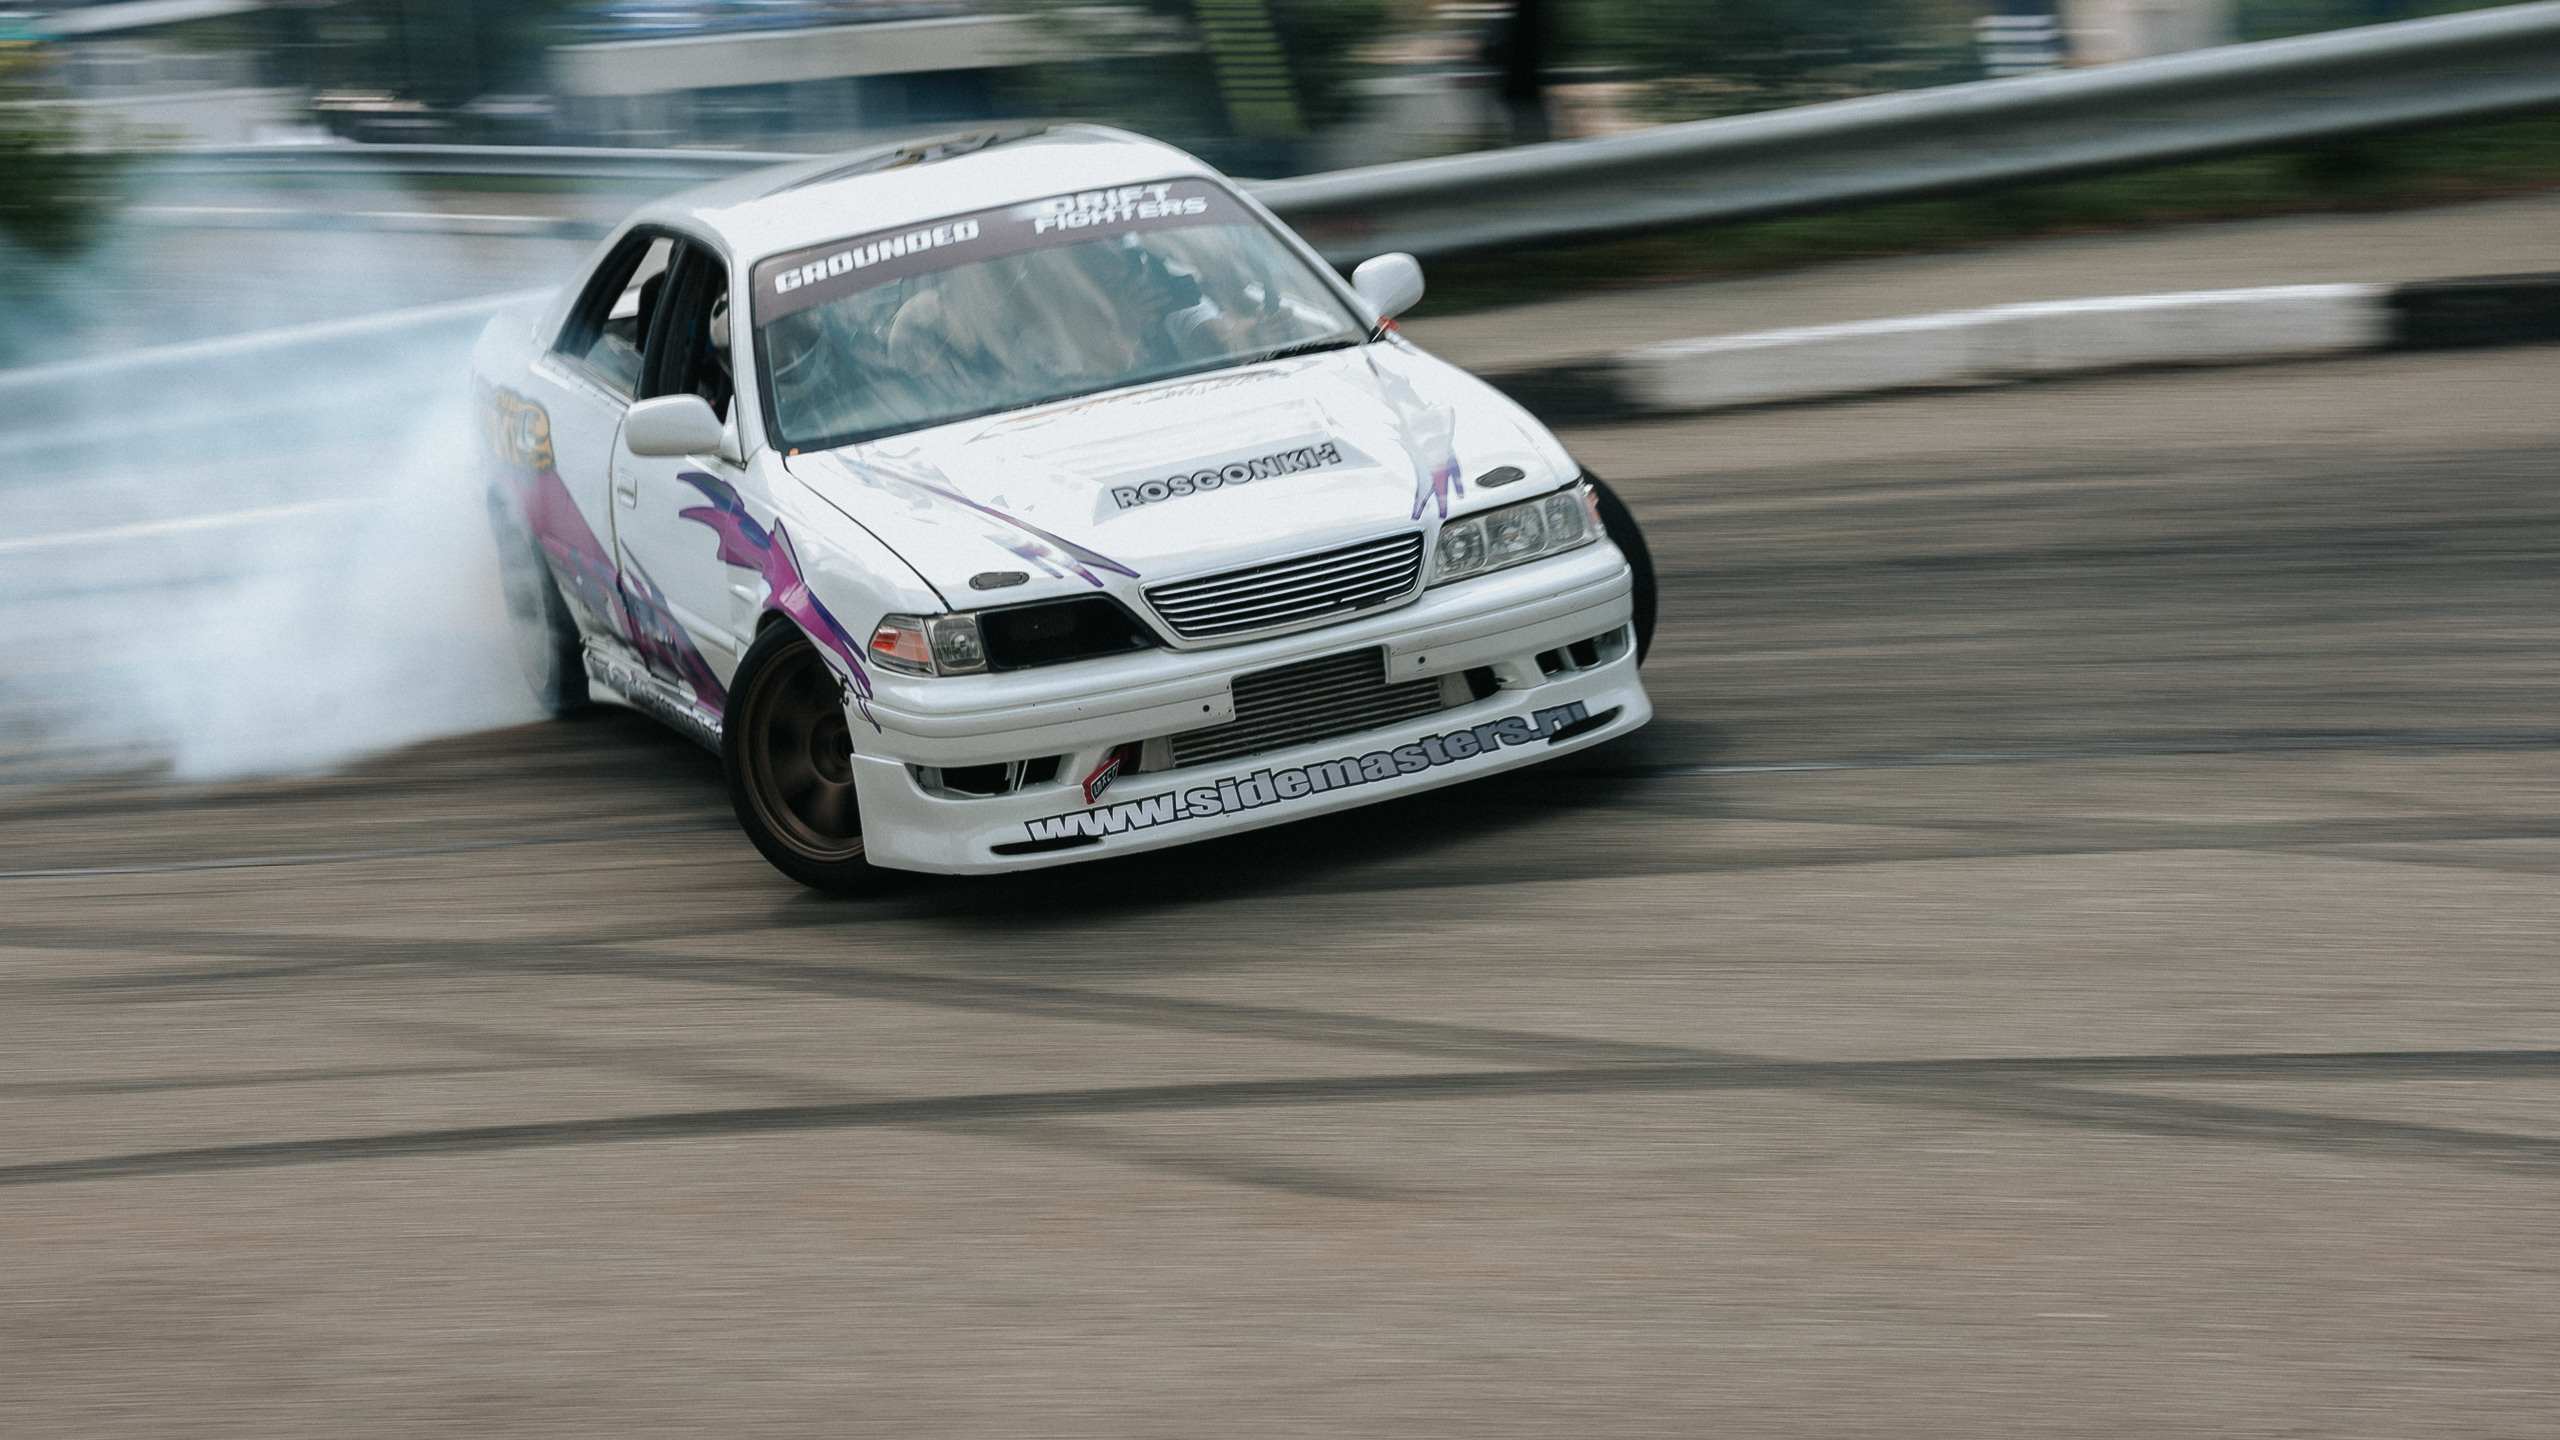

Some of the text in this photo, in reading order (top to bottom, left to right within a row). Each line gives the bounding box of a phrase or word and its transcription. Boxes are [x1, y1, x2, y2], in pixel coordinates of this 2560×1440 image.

[1034, 196, 1208, 234] FIGHTERS
[1048, 184, 1172, 217] DRIFT
[775, 220, 979, 294] GROUNDED
